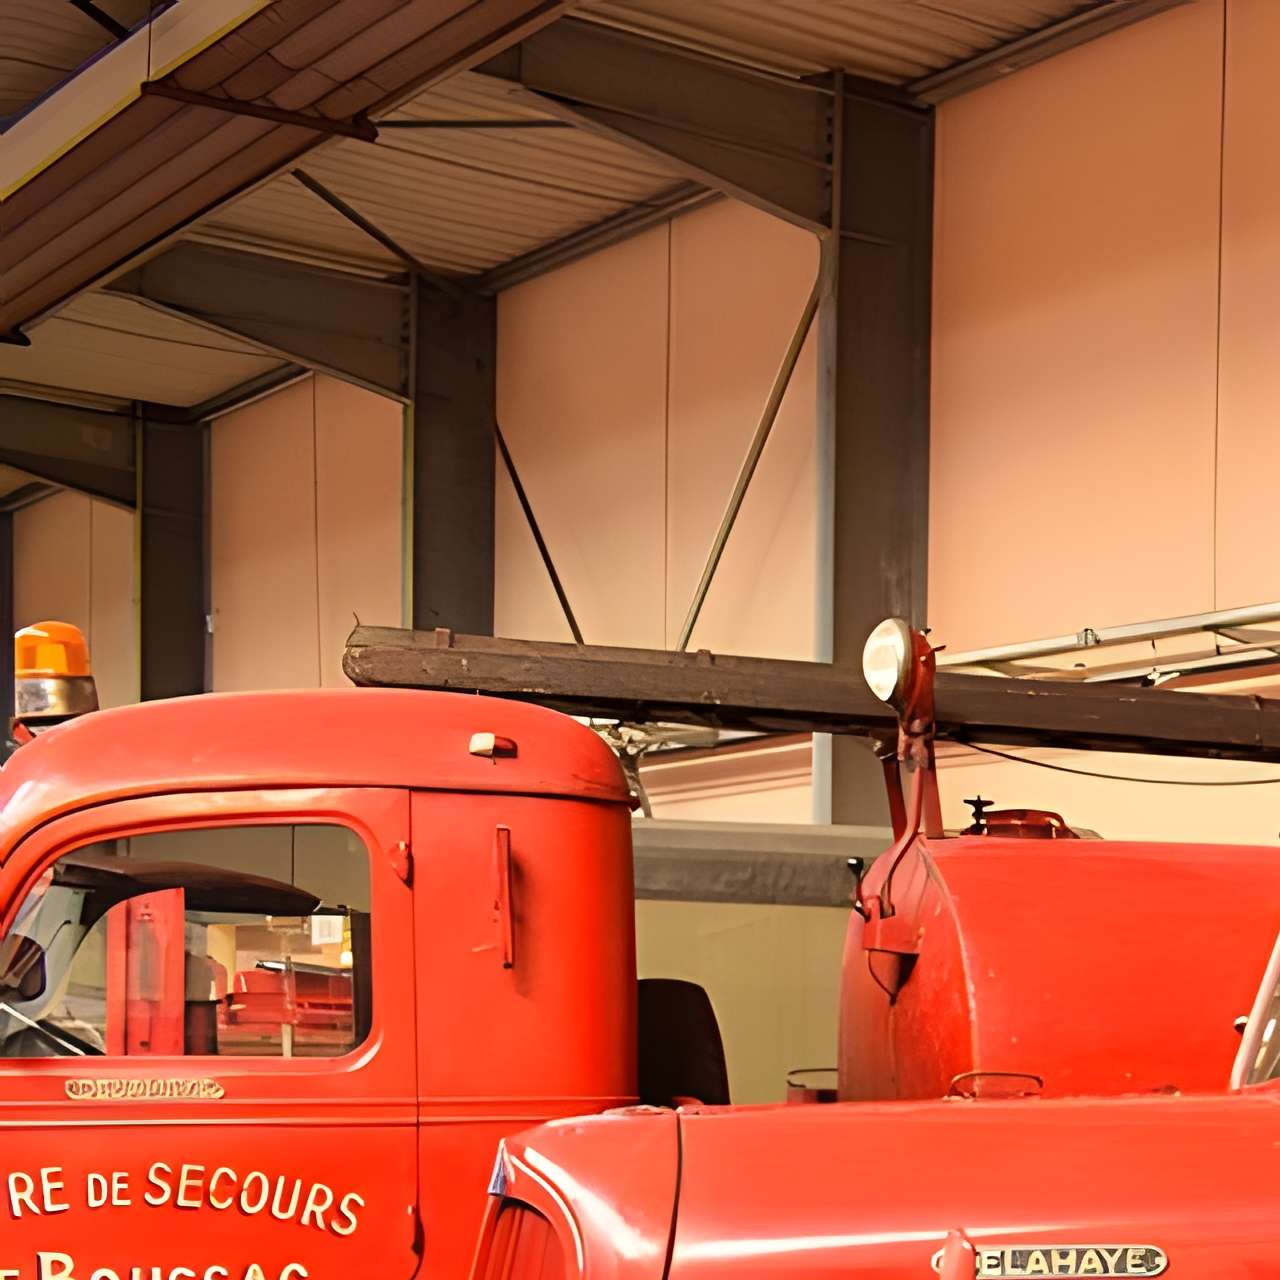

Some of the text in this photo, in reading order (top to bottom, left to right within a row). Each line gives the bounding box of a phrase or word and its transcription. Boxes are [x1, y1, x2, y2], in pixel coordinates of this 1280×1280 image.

[87, 1172, 131, 1208] DE
[144, 1162, 365, 1236] SECOURS
[975, 1248, 1149, 1275] ELAHAYE
